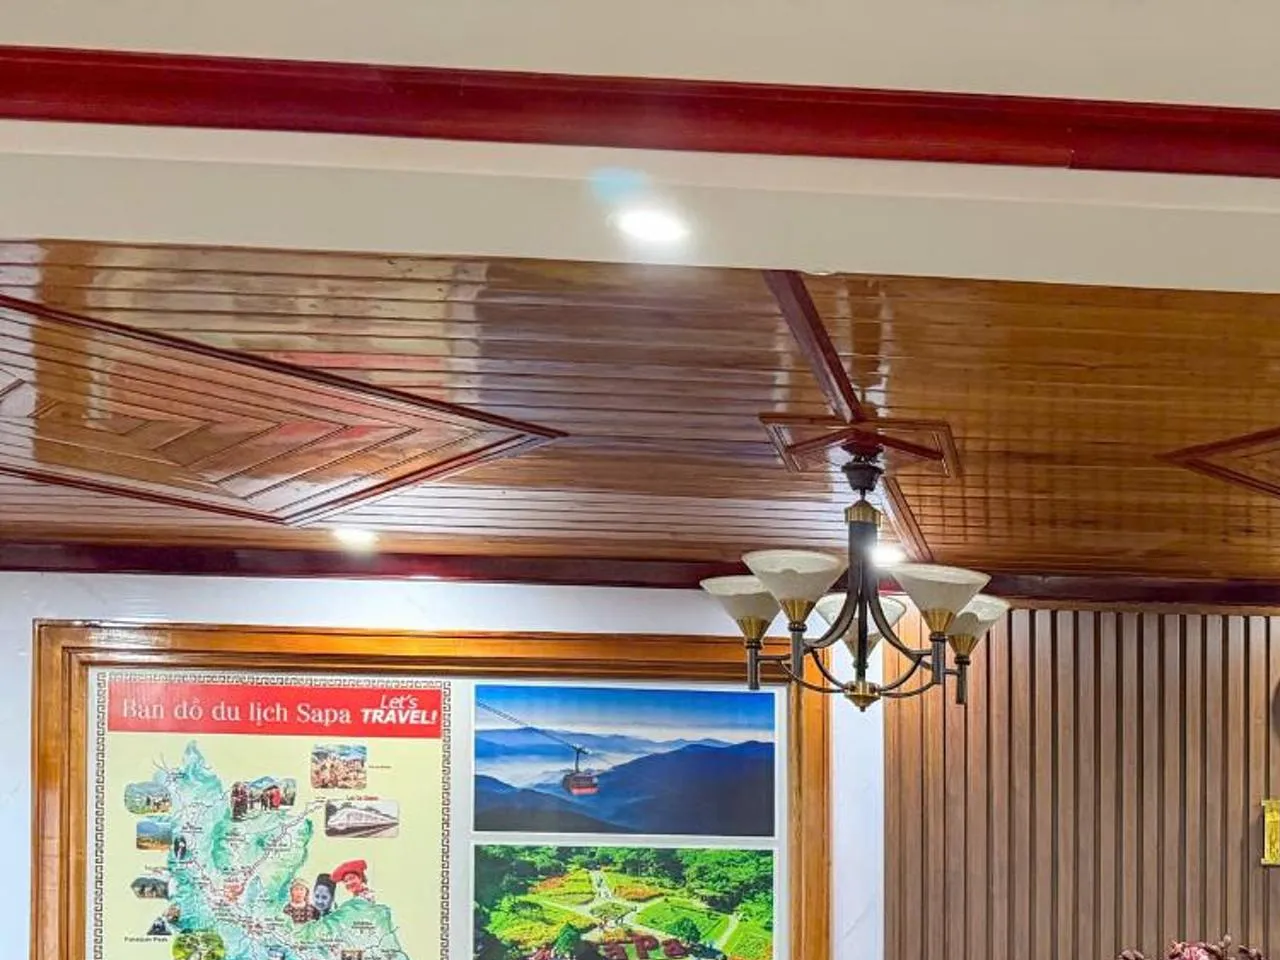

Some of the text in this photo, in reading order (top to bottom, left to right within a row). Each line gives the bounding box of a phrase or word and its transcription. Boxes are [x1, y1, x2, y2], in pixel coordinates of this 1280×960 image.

[212, 700, 240, 721] du
[296, 702, 352, 727] Sapa
[360, 708, 438, 725] TRAVEL!
